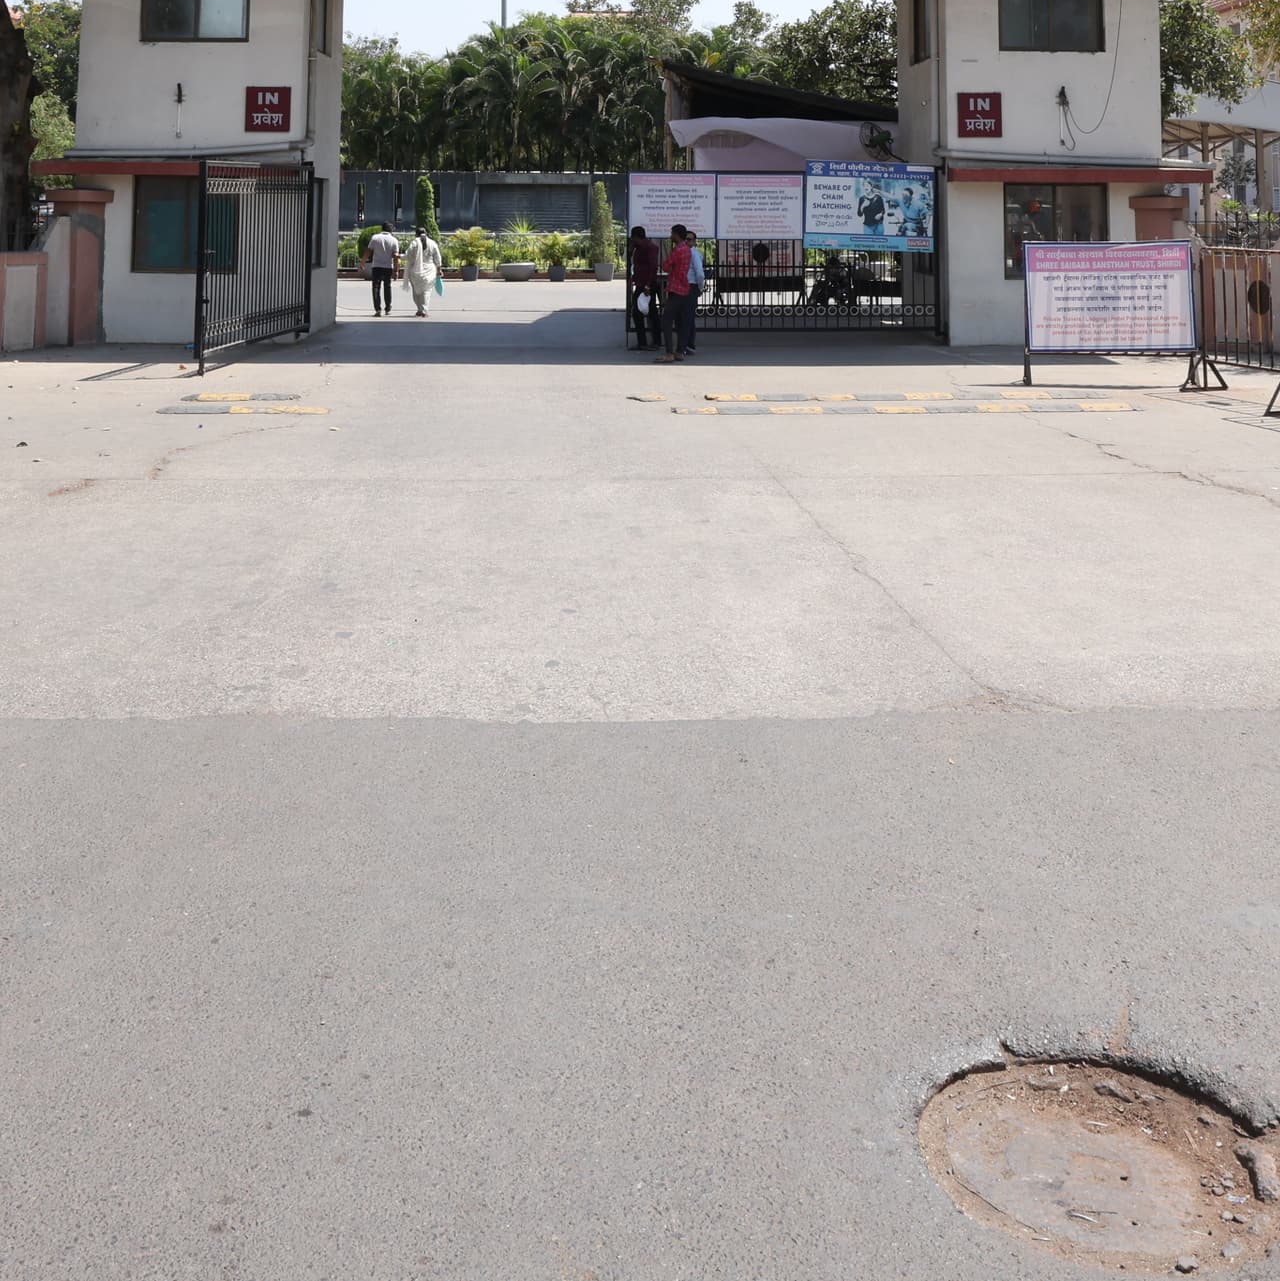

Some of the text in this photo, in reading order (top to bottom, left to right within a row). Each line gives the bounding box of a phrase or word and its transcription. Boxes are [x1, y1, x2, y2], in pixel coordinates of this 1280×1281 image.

[257, 92, 279, 105] IN
[969, 98, 991, 111] IN
[251, 107, 284, 127] प्रवेश
[964, 113, 996, 132] प्रवेश
[812, 202, 852, 210] SNATCHING
